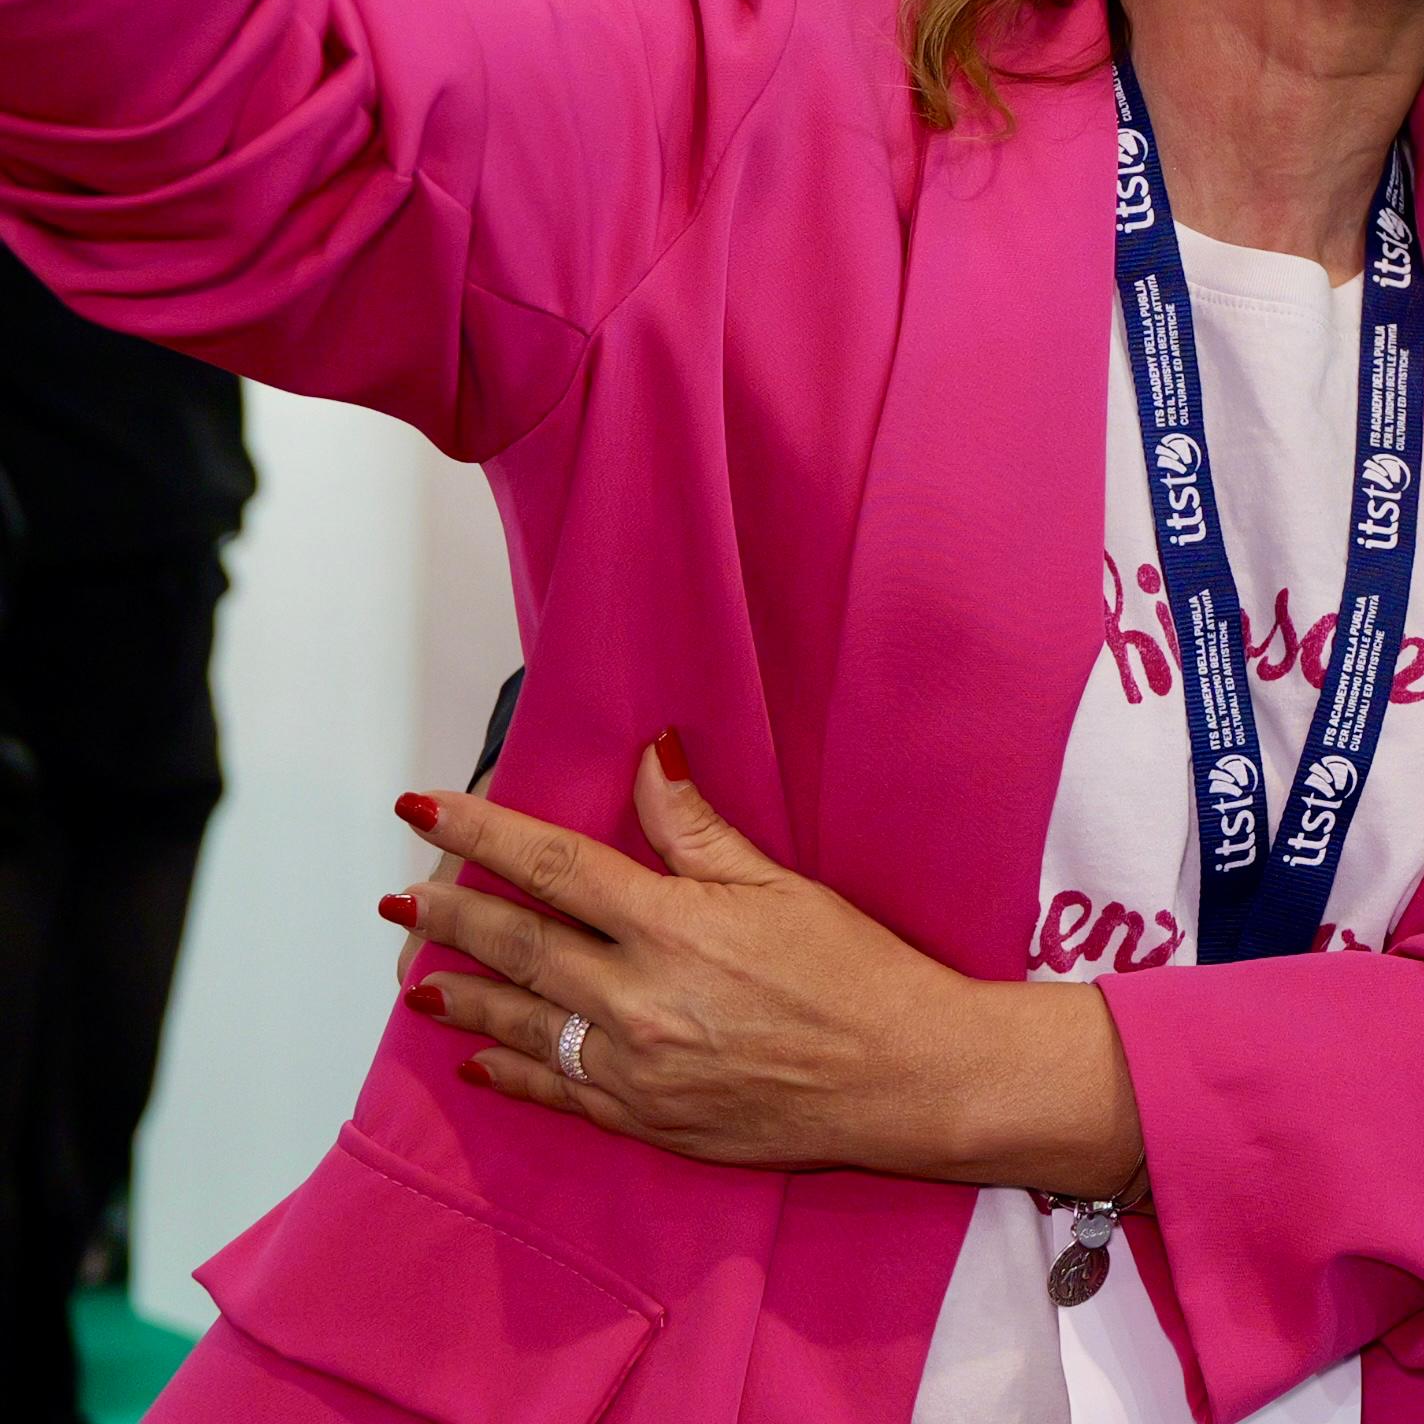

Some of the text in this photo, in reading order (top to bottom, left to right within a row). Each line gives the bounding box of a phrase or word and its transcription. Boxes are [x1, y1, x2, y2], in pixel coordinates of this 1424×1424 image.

[1134, 280, 1165, 427] ITS ACADEMY DELLA PUGLIA
[1160, 355, 1174, 395] TURISMO
[1165, 303, 1189, 425] CULTURALI ED ARTISTICHE
[1370, 326, 1386, 447] ITS ACADEMY DELLA PUGLIA
[1384, 391, 1395, 424] TURISMO
[1395, 348, 1409, 451] CULTURALI ED ARTISTICHE
[1189, 595, 1221, 750] ITS ACADEMY DELLA PUGLIA
[1212, 675, 1228, 716] TURISMO
[1218, 620, 1246, 745] CULTURALI ED ARTISTICHE
[1323, 596, 1367, 746] ITS ACADEMY DELLA PUGLIA
[1345, 676, 1363, 718] TURISMO
[1349, 629, 1385, 751] CULTURALI ED ARTISTICHE
